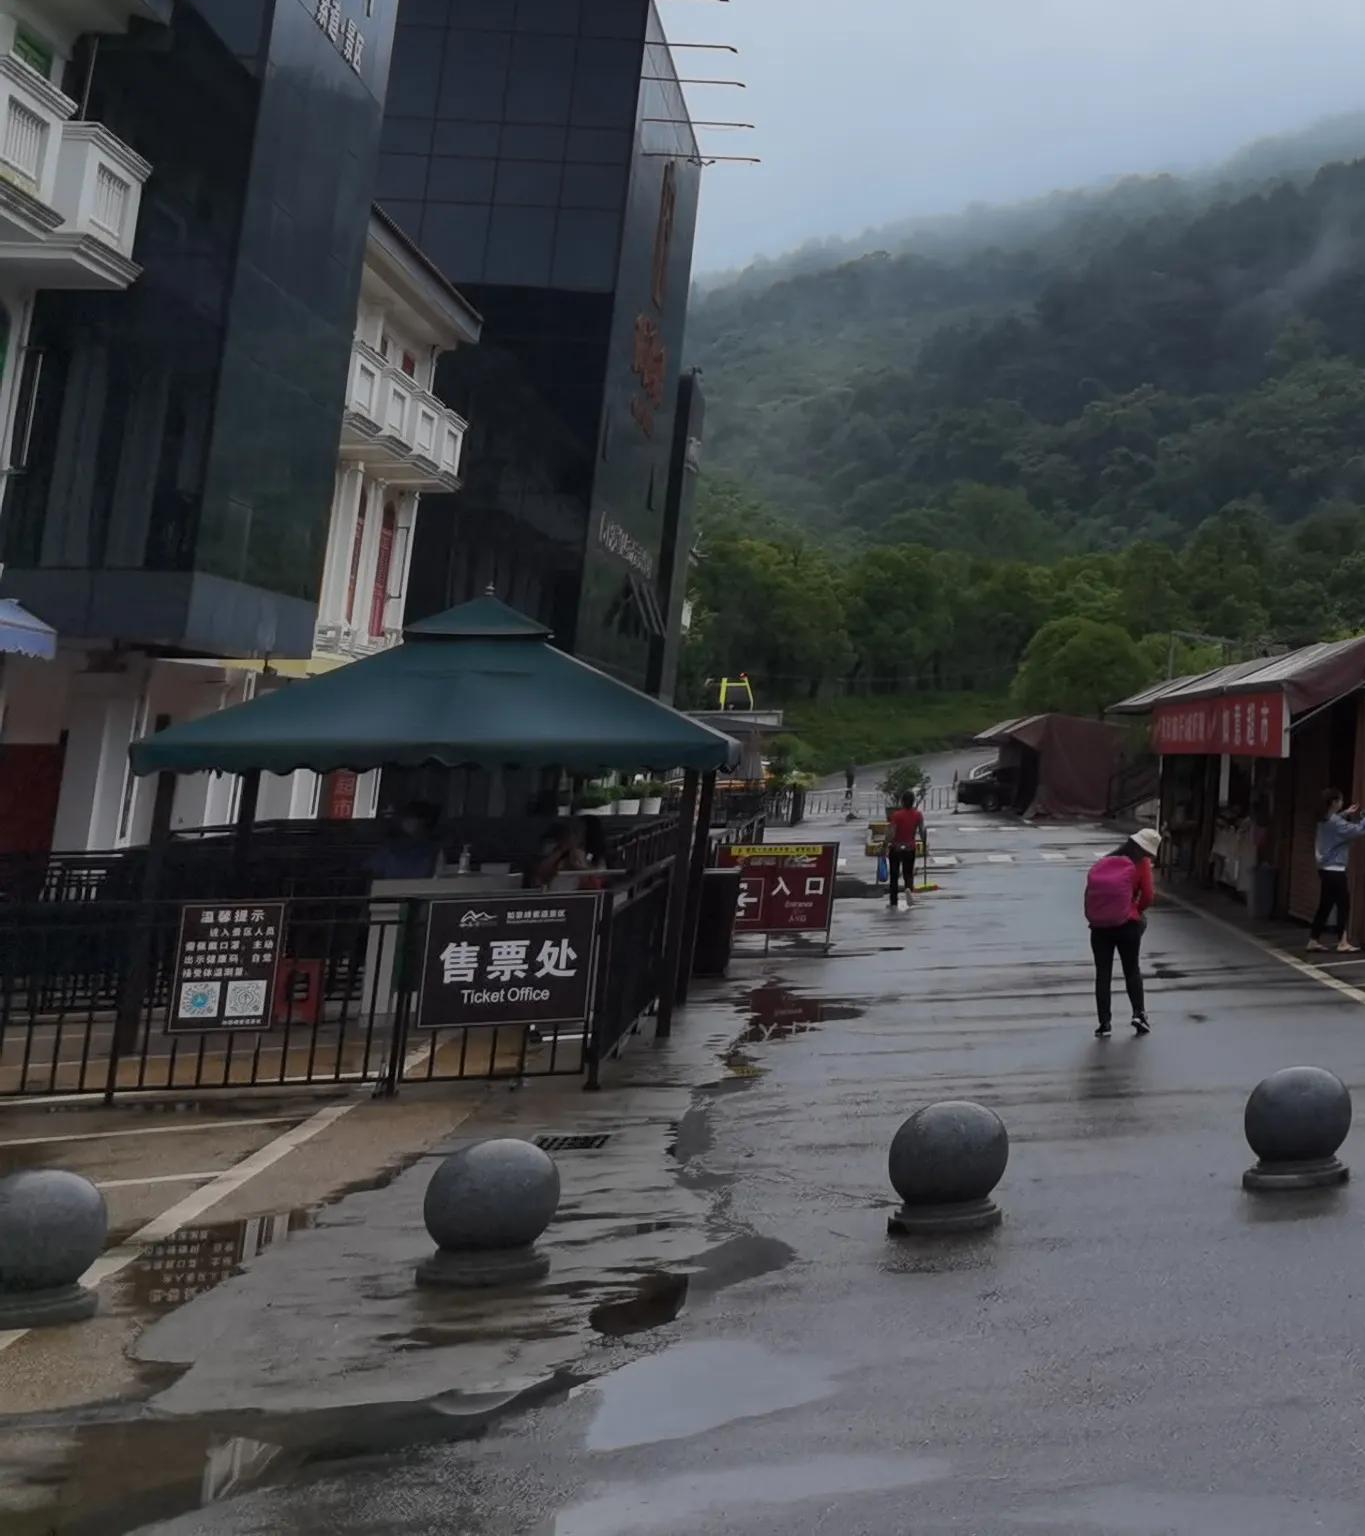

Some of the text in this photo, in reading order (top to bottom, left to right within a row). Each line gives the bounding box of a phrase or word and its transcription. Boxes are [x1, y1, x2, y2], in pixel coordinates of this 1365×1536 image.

[771, 876, 825, 896] 入口
[200, 909, 265, 924] 温馨提示
[439, 938, 578, 984] 售票处
[461, 986, 550, 1004] Ticket Office
